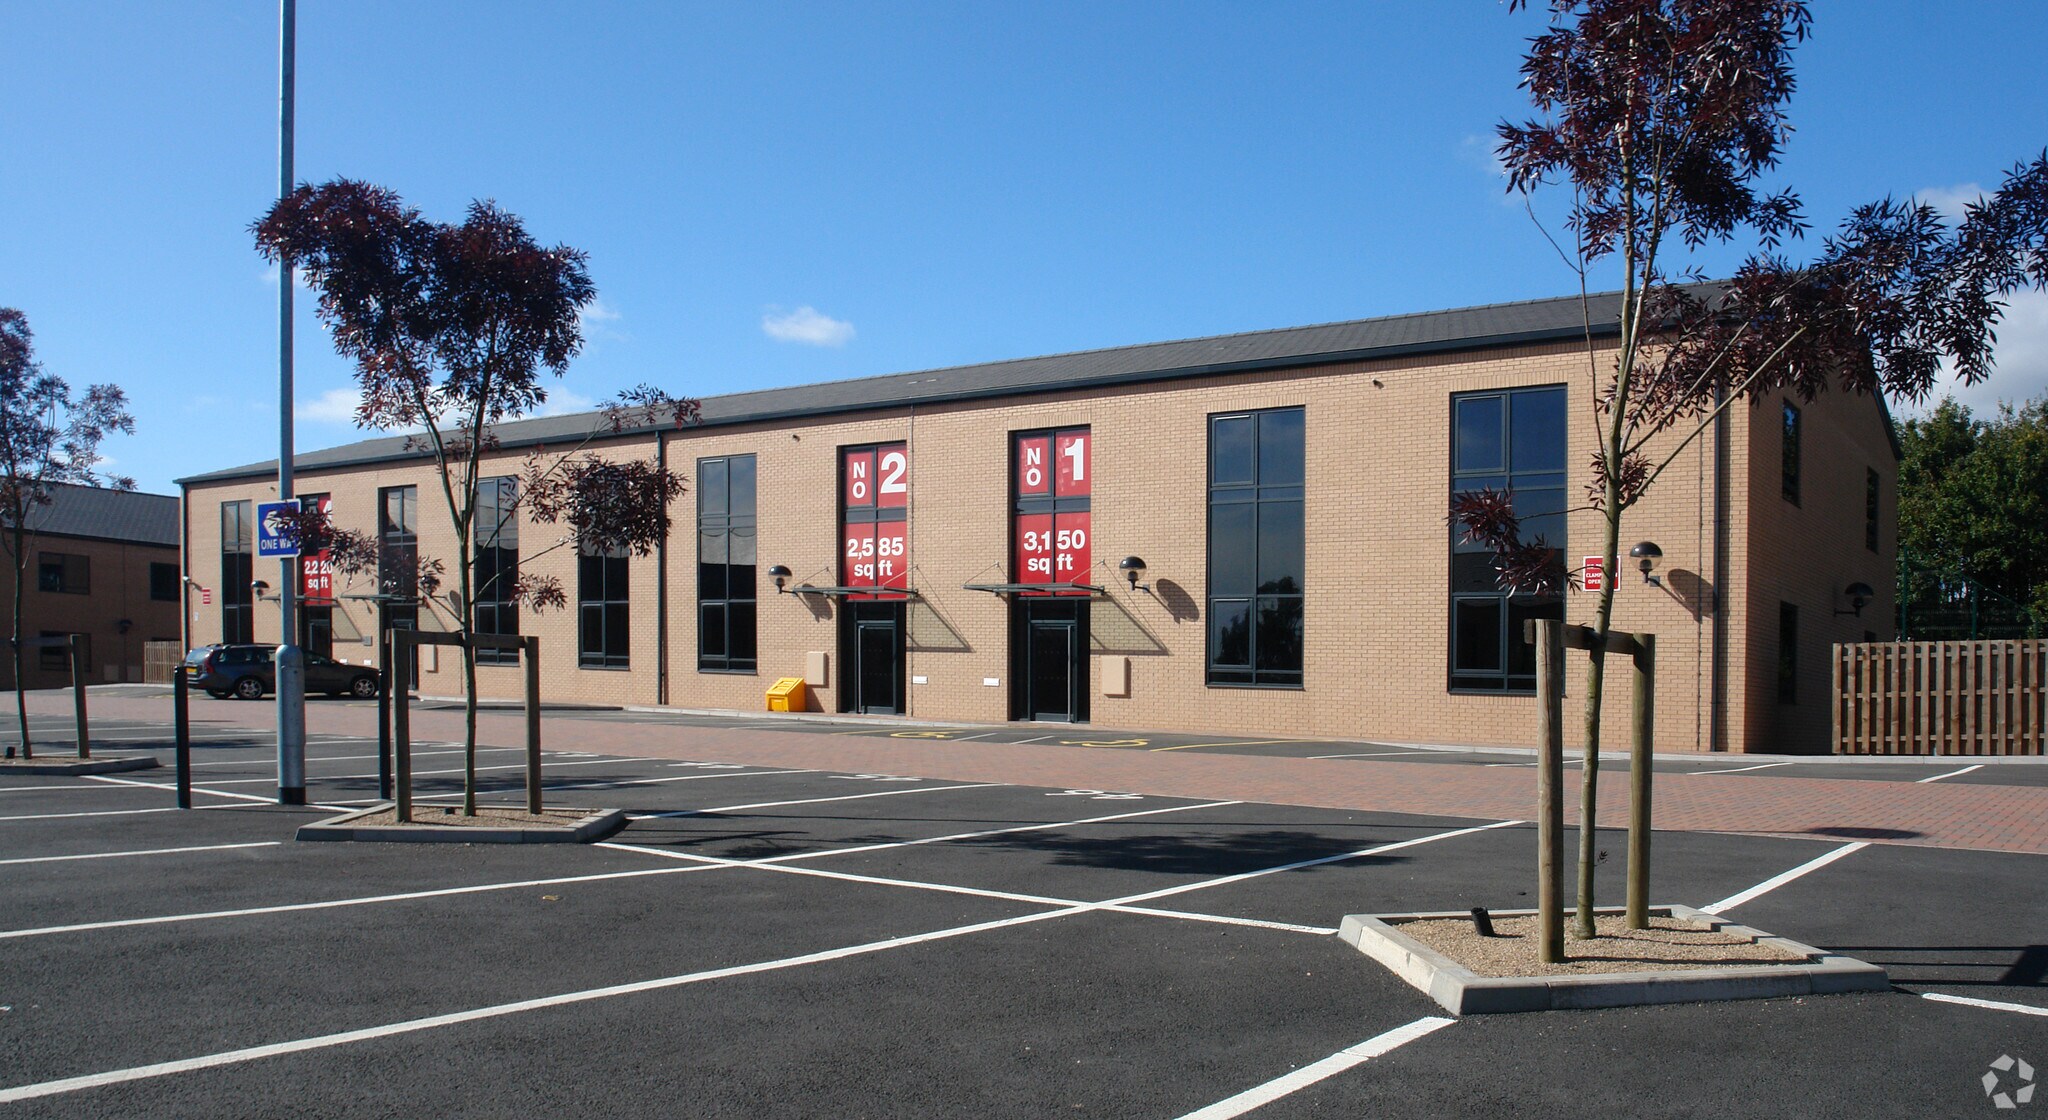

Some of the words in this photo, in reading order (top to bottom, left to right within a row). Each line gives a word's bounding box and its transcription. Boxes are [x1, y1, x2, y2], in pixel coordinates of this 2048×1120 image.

[1064, 438, 1084, 481] 1
[880, 452, 907, 494] 2
[261, 540, 277, 550] ONE
[280, 540, 296, 549] WA
[847, 537, 904, 560] 2,585
[1023, 529, 1086, 554] 3,150
[304, 560, 333, 577] 2,220
[854, 563, 874, 580] sq
[878, 559, 892, 576] ft
[1027, 556, 1050, 575] sq
[1056, 553, 1073, 571] ft
[308, 577, 319, 591] sq
[320, 576, 328, 588] ft
